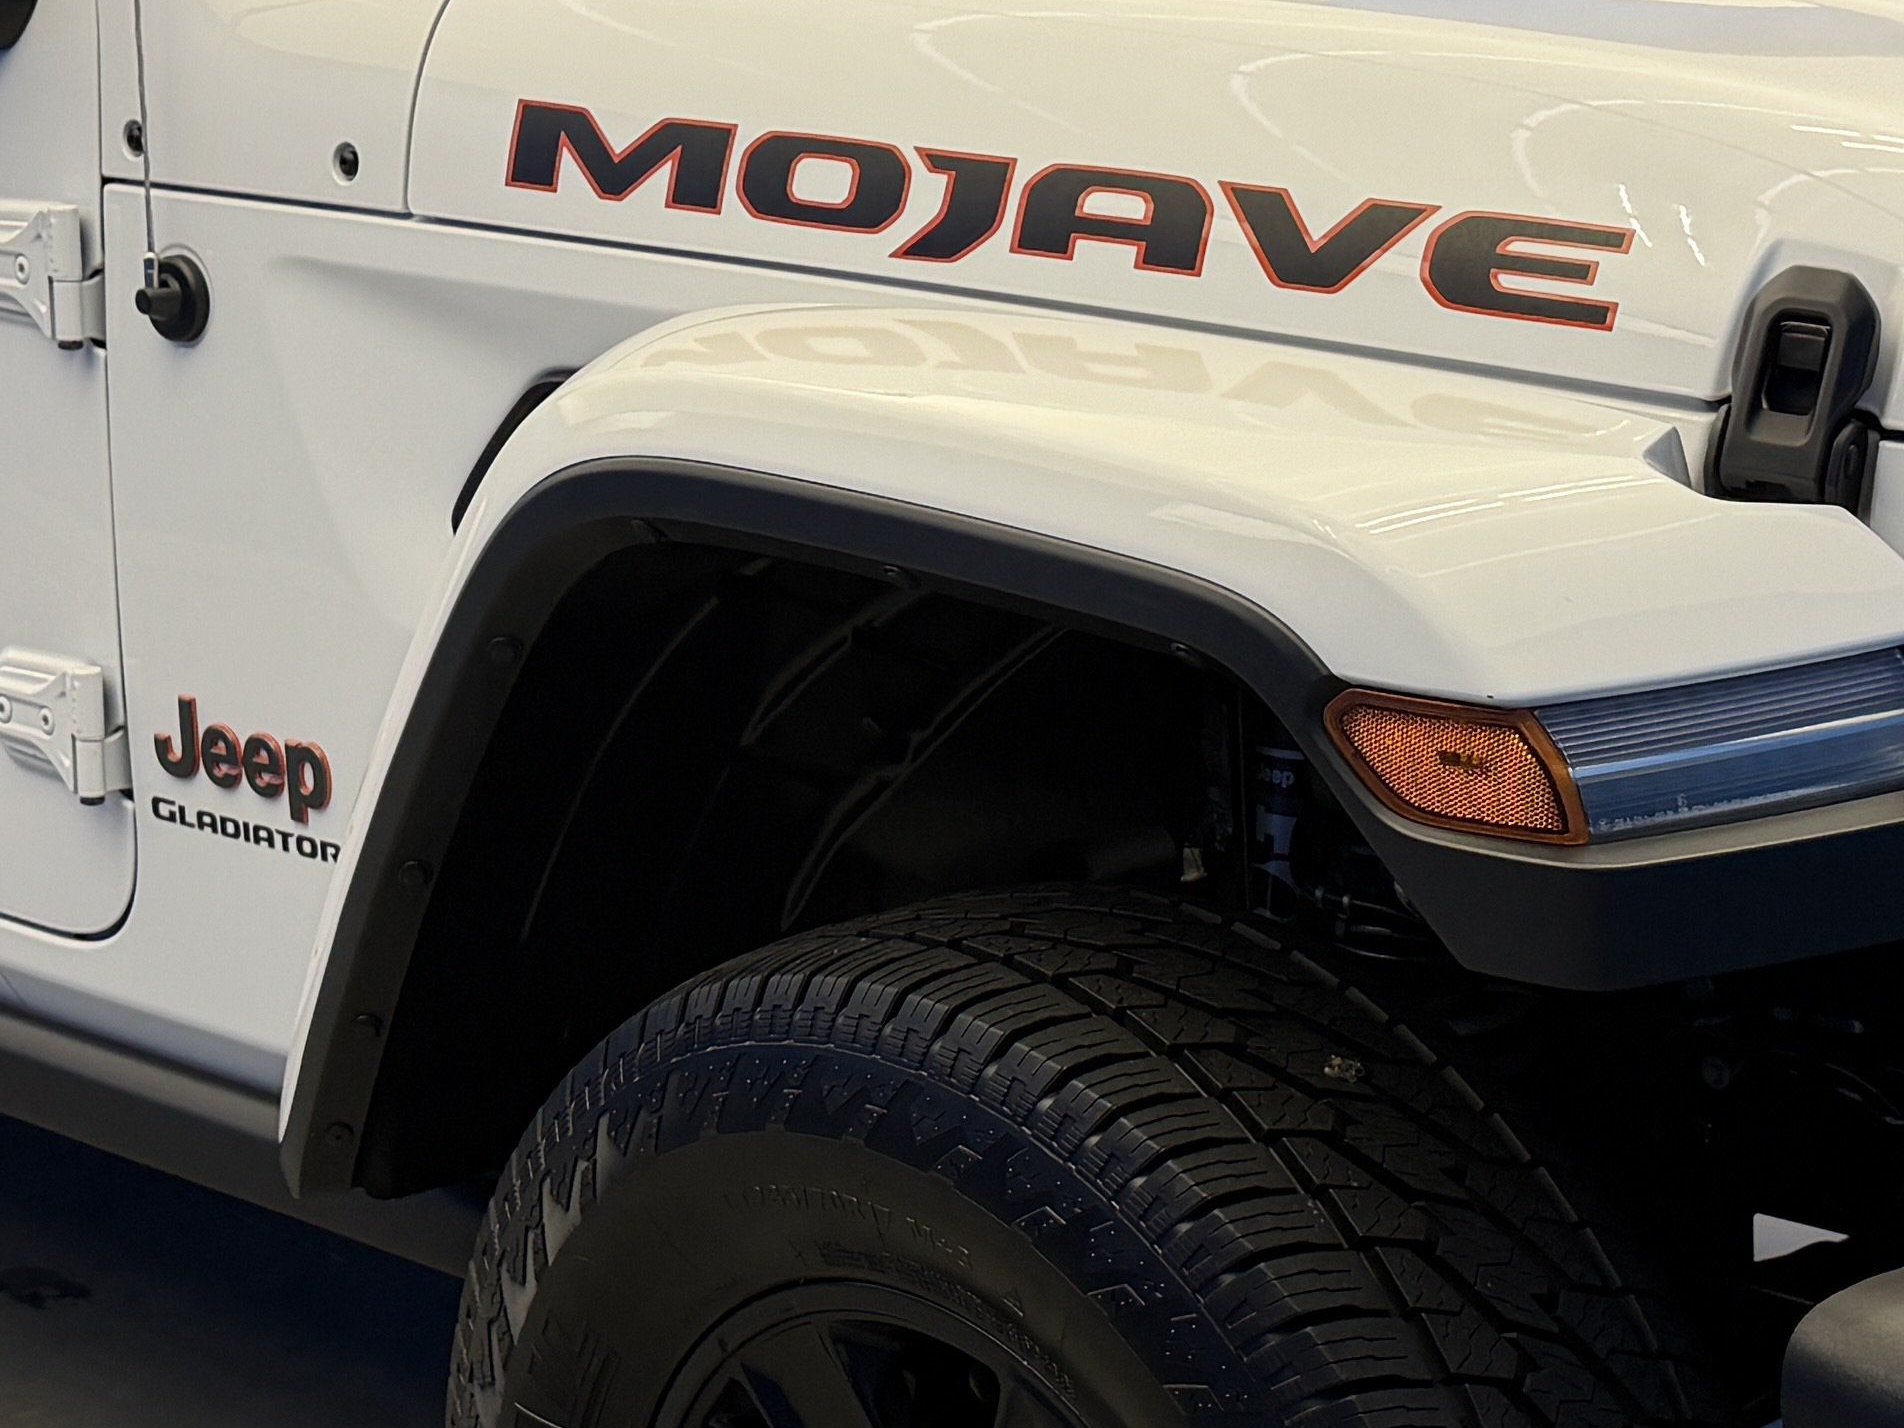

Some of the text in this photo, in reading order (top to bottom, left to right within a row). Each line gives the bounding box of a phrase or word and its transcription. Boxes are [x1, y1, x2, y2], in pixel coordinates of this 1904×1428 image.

[504, 97, 1636, 333] MOJAVE
[153, 693, 333, 825] Jeep
[150, 795, 342, 864] GLADIATOR
